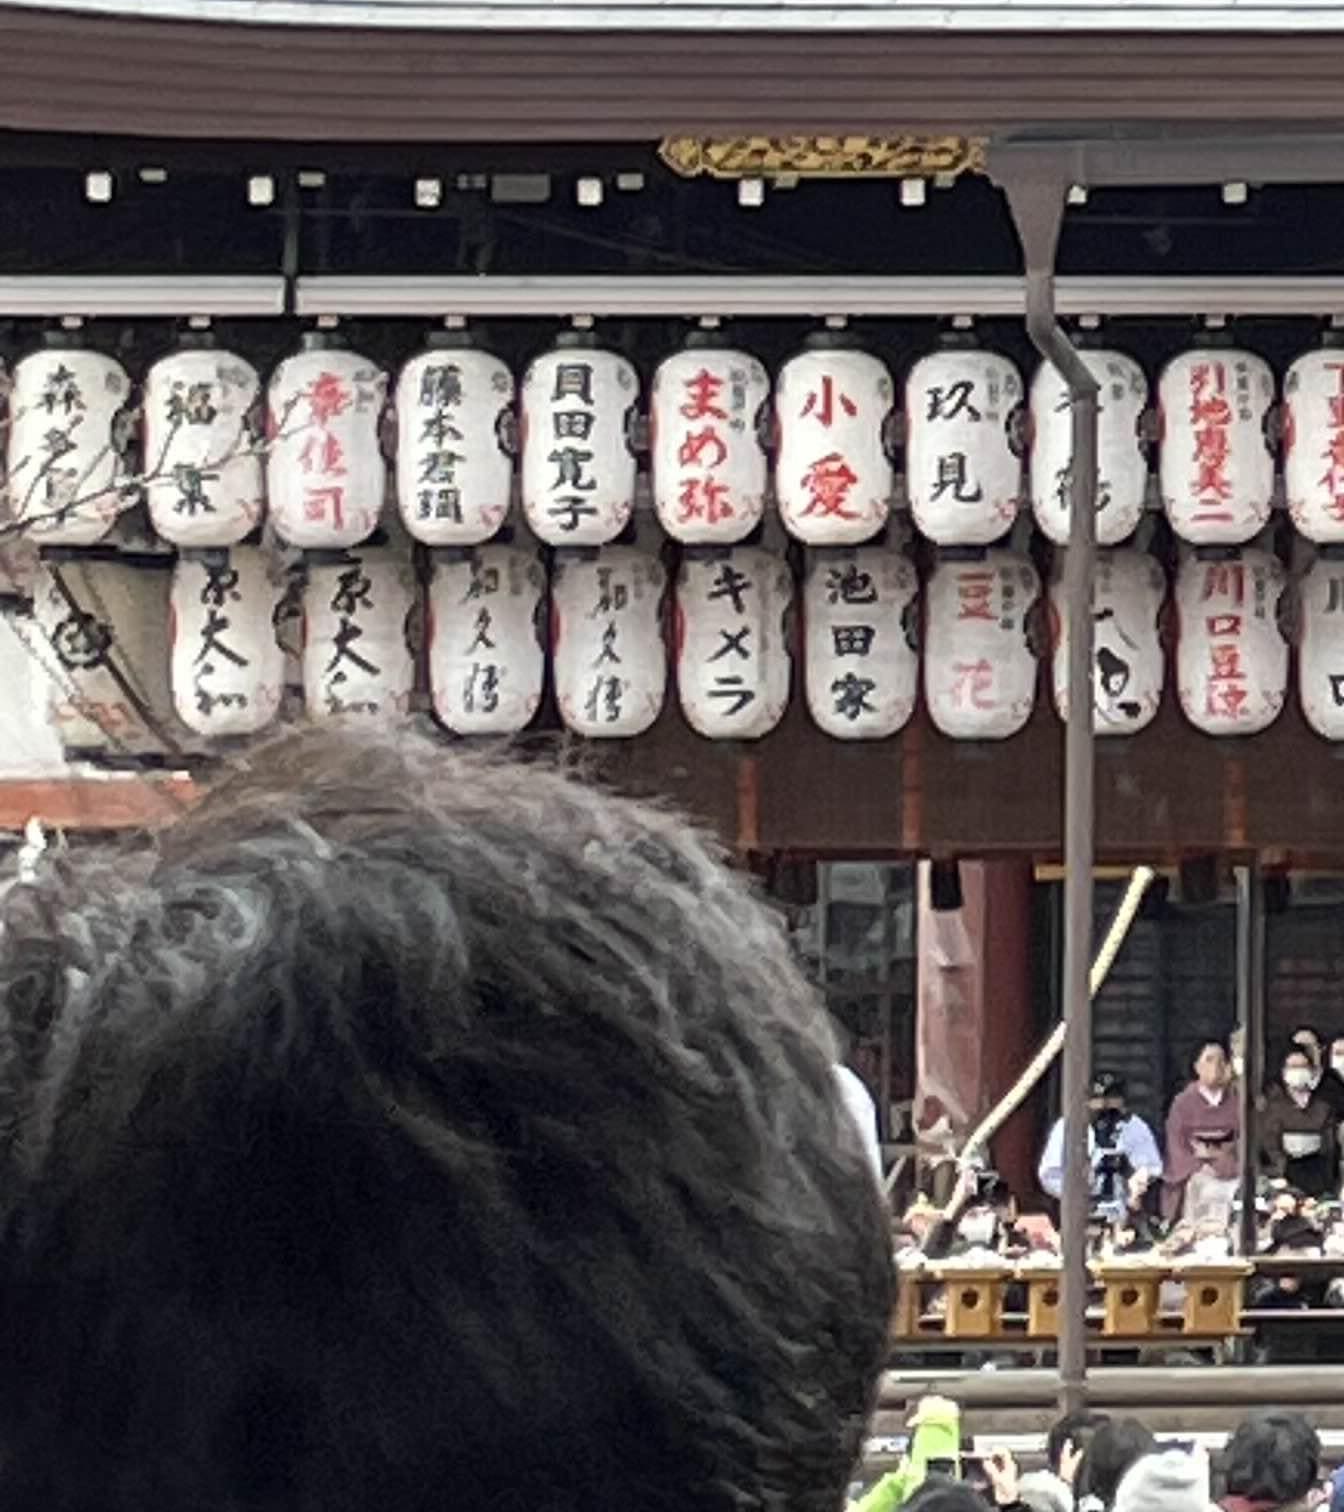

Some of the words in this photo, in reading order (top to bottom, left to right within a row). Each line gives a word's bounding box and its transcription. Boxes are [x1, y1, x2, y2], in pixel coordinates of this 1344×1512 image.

[547, 363, 598, 531] 貝田寛子
[678, 368, 735, 525] まめ弥
[797, 375, 862, 520] 小愛
[926, 380, 984, 503] 玖見
[706, 564, 756, 717] キメラ
[825, 564, 880, 722] 池田家
[953, 571, 999, 710] 豆花
